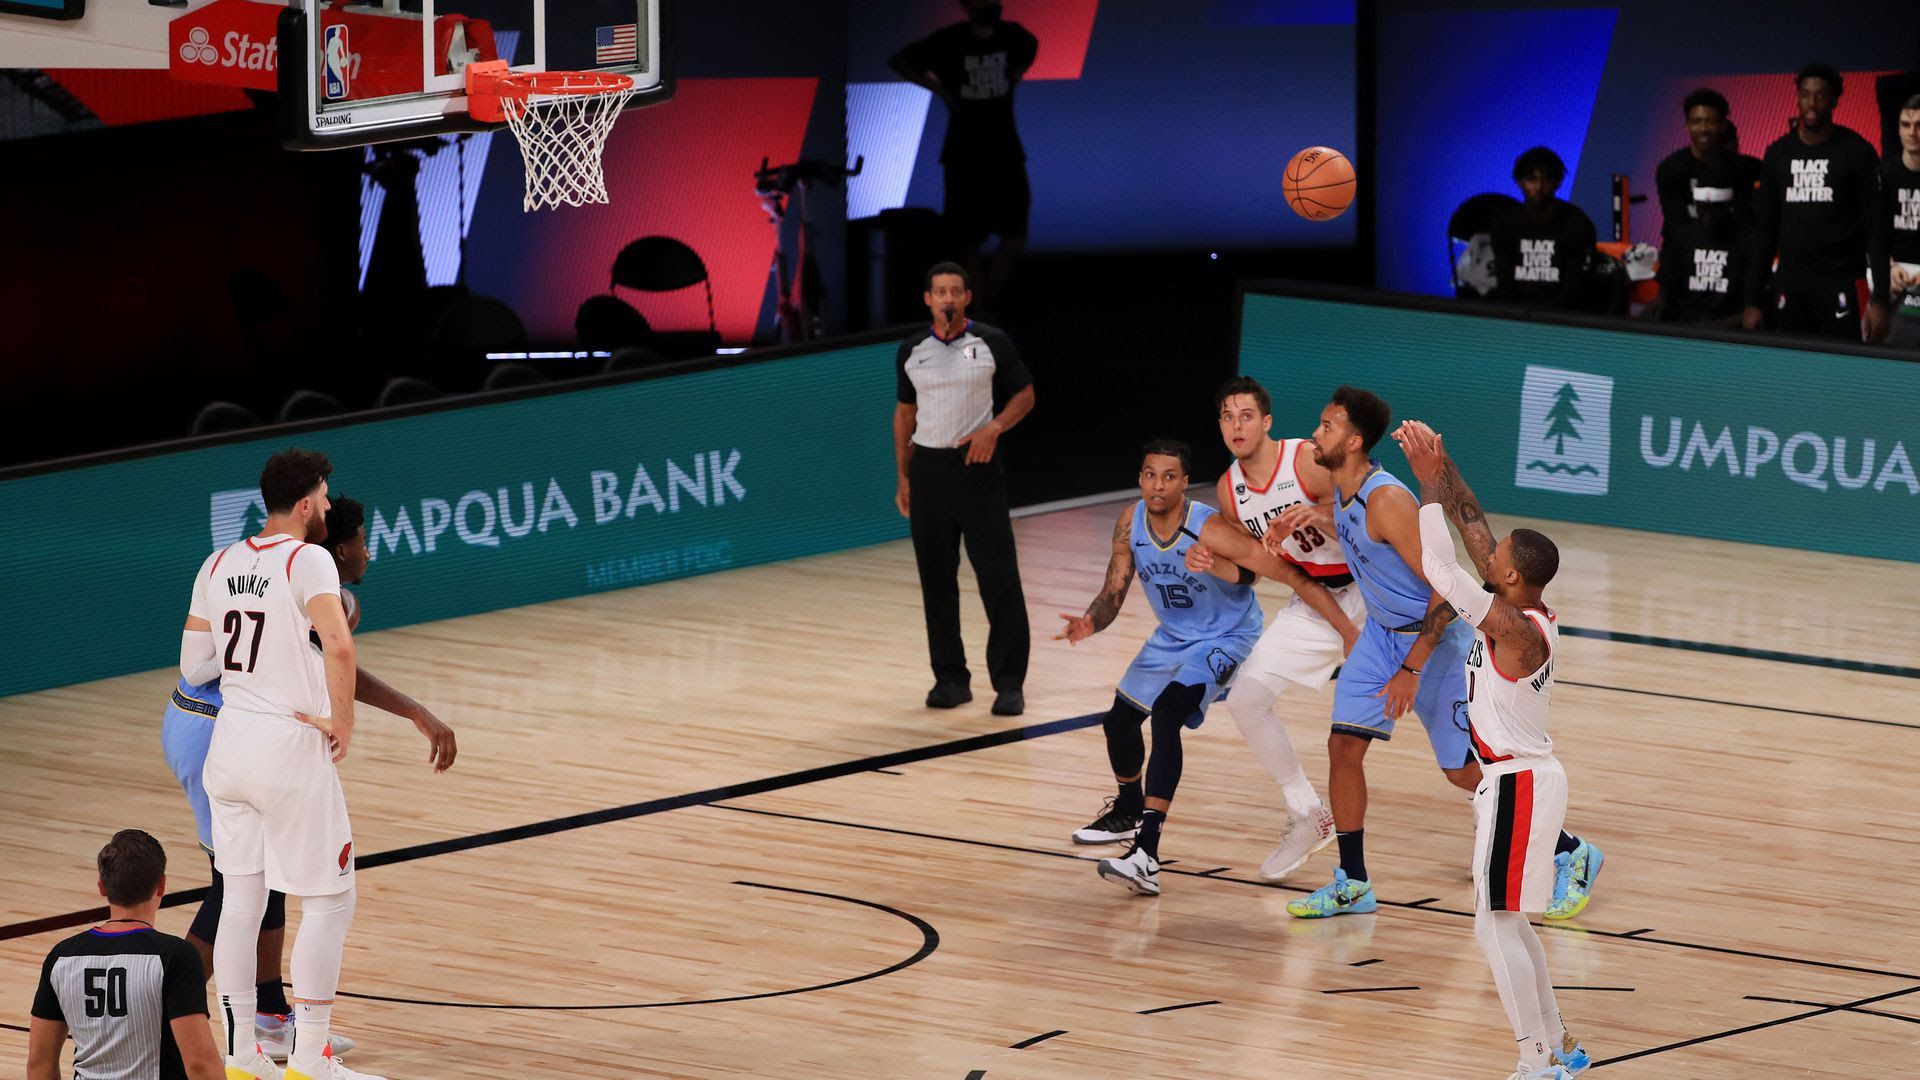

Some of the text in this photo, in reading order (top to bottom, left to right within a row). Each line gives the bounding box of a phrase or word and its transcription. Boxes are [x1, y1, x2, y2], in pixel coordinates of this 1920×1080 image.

[221, 31, 278, 71] Stat
[328, 82, 342, 95] NBA
[315, 113, 351, 128] SPALDING
[1791, 159, 1829, 174] BLACK
[1793, 173, 1825, 187] LIVES
[1786, 186, 1833, 202] MATTER
[1520, 239, 1555, 254] BLACK
[1694, 249, 1728, 265] BLACK
[1514, 265, 1559, 282] MATTER
[1696, 262, 1723, 277] LIVES
[1640, 414, 1920, 495] UMPQUA
[368, 448, 746, 561] MPQUA BANK
[1292, 525, 1325, 553] 33
[1139, 563, 1207, 593] GIZZLIES
[1155, 584, 1193, 609] 15
[223, 609, 266, 674] 27
[84, 967, 128, 1018] 50
